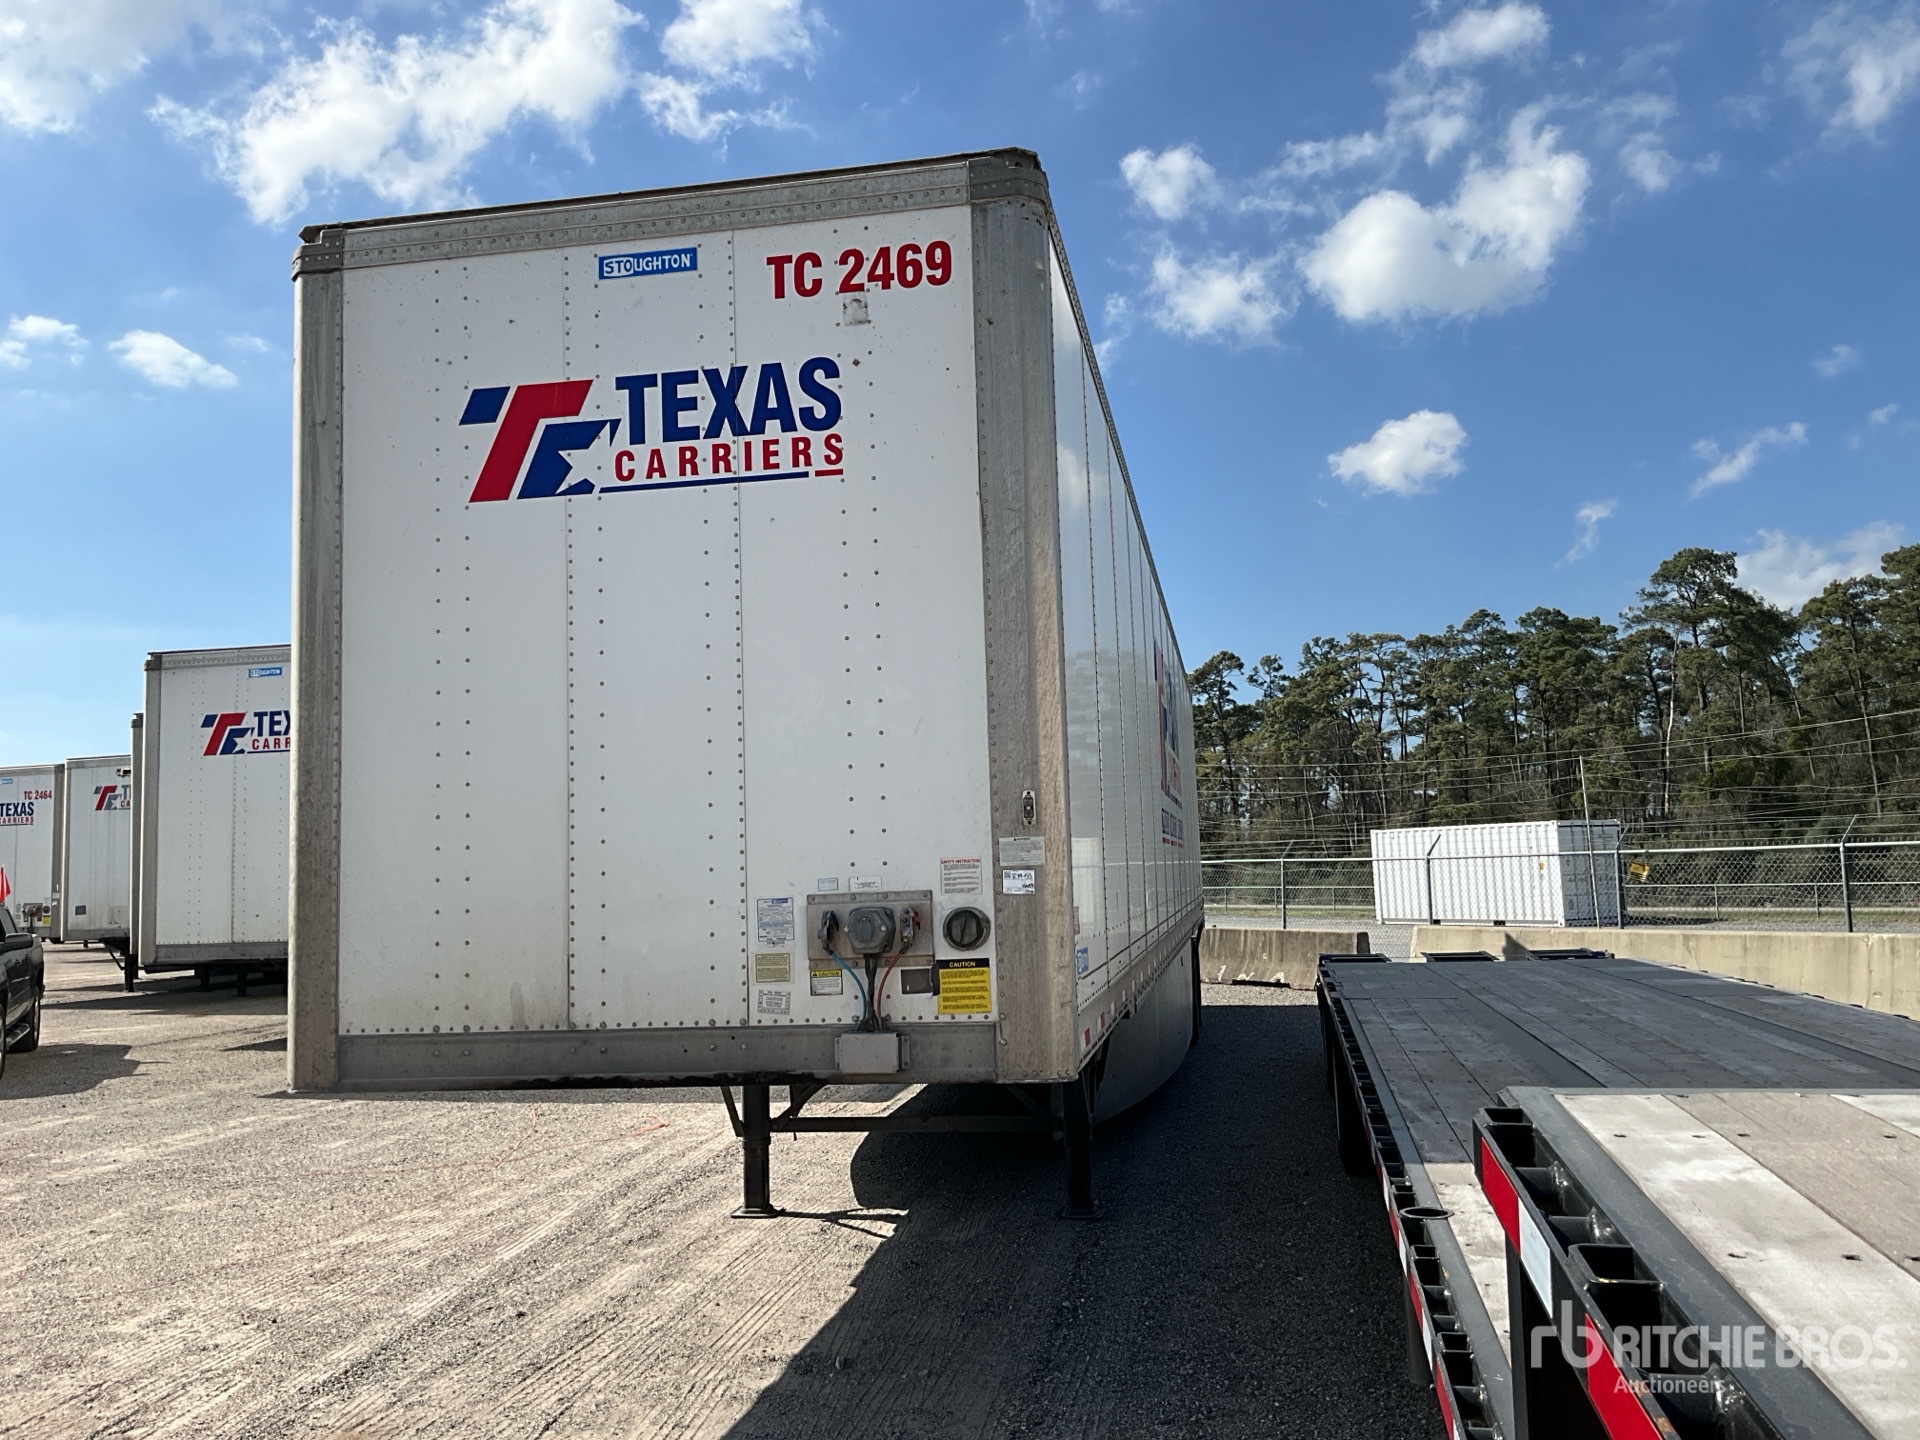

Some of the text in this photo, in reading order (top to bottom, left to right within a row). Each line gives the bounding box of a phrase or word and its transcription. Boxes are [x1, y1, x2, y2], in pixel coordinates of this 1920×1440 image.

[604, 253, 692, 275] STOUGHTON
[766, 240, 952, 299] TC 2469
[614, 356, 843, 446] TEXAS
[614, 433, 844, 482] CARRIERS
[24, 790, 52, 800] TC 2464
